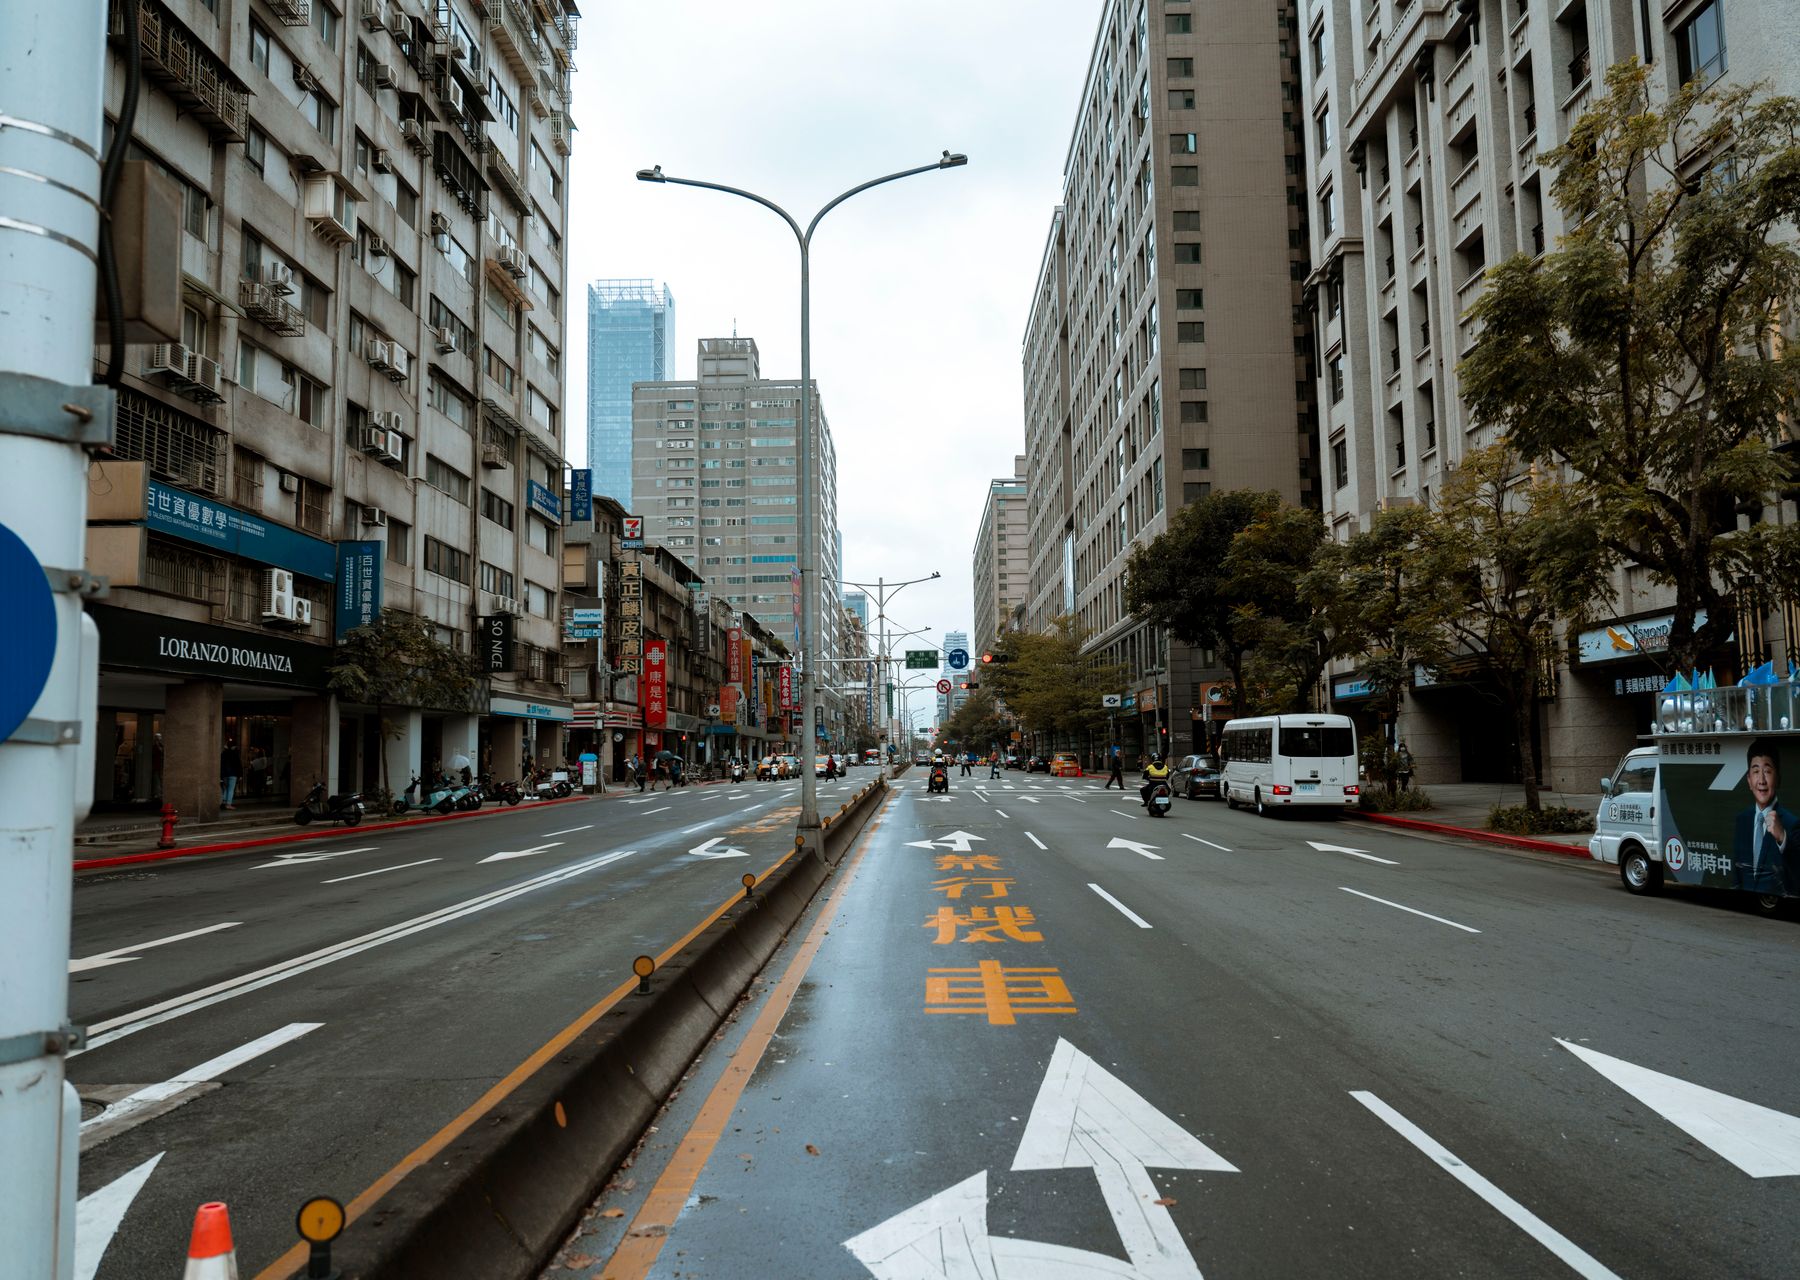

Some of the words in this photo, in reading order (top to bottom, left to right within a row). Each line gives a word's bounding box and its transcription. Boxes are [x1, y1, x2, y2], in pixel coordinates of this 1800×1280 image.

[492, 620, 503, 637] SO
[159, 636, 229, 664] LORANZO
[231, 648, 293, 674] ROMANZA
[492, 641, 503, 669] NICE
[649, 671, 663, 714] 康是美
[1609, 806, 1617, 818] 12
[1620, 810, 1643, 823] 陳時中
[1667, 844, 1682, 865] 12
[1687, 851, 1732, 876] 陳時中
